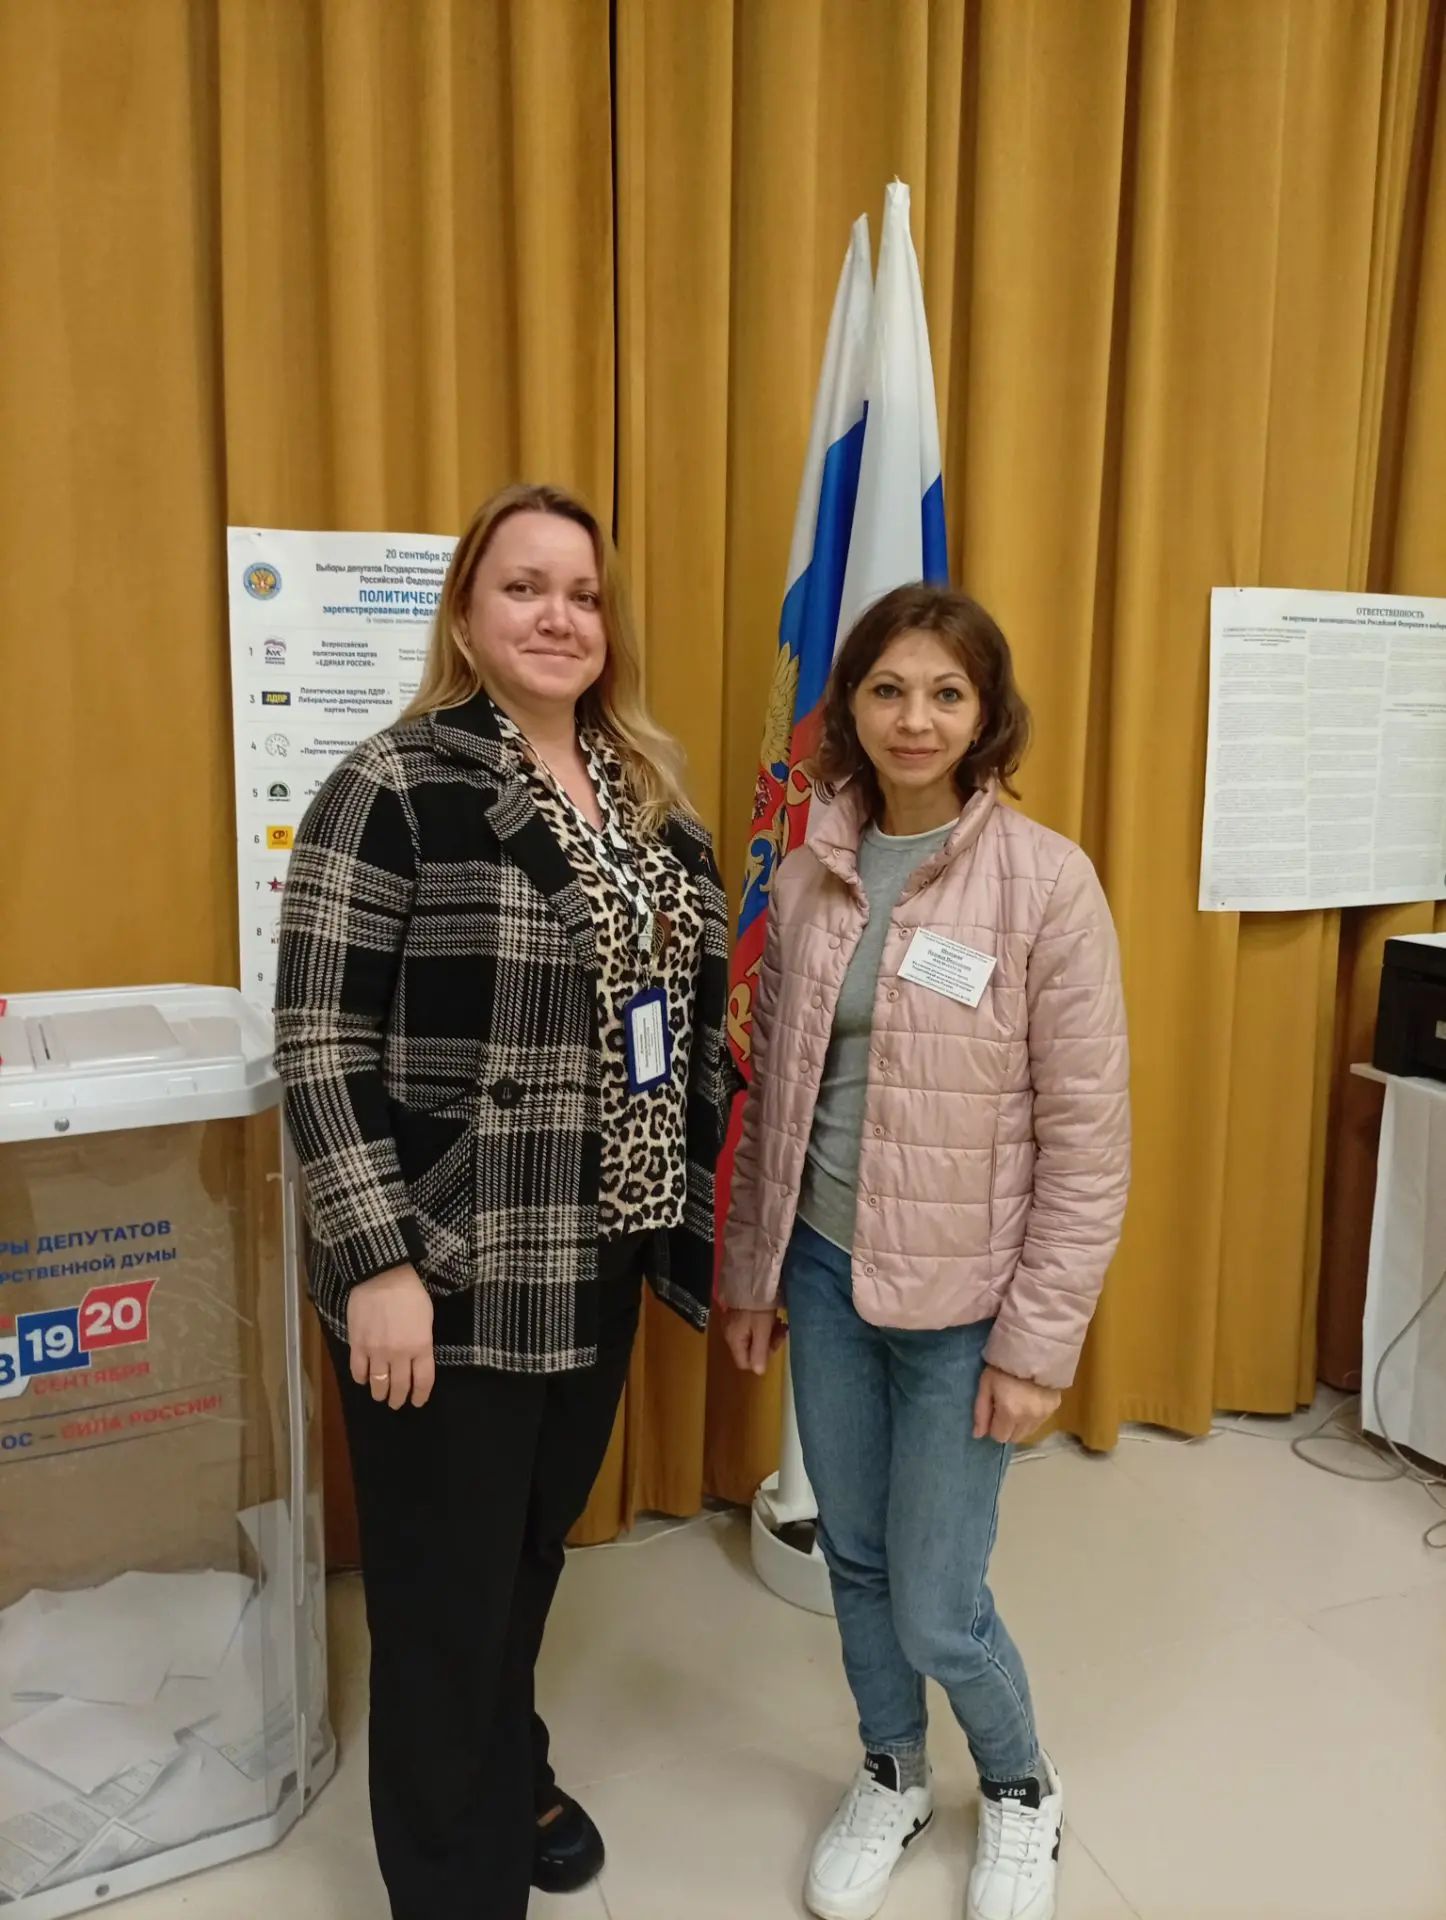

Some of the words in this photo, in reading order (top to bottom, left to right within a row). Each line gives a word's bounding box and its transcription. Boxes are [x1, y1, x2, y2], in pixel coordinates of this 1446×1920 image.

[386, 549, 397, 559] 20
[399, 550, 440, 564] сентября
[442, 552, 455, 562] 20
[316, 563, 346, 573] Выборы
[347, 565, 382, 575] депутатов
[384, 564, 444, 575] Государственной
[360, 576, 404, 585] Российской
[406, 576, 446, 587] Федераци
[323, 606, 410, 616] зарегистрировавшие
[1356, 607, 1424, 619] ОТВЕТСТВЕННОСТЬ
[321, 640, 369, 649] Всероссийская
[300, 687, 349, 696] Политическая
[265, 693, 289, 705] ЛДПР
[252, 788, 258, 798] 5
[254, 834, 260, 844] 6
[255, 882, 260, 891] 7
[257, 927, 262, 937] 8
[257, 972, 263, 982] 9
[37, 1220, 171, 1254] ДЕПУТАТОВ
[120, 1248, 176, 1269] ДУМЫ
[25, 1324, 74, 1362] 19
[85, 1297, 142, 1337] 20
[33, 1361, 150, 1396] СЕНТЯБРЯ
[62, 1415, 124, 1440] СИЛА
